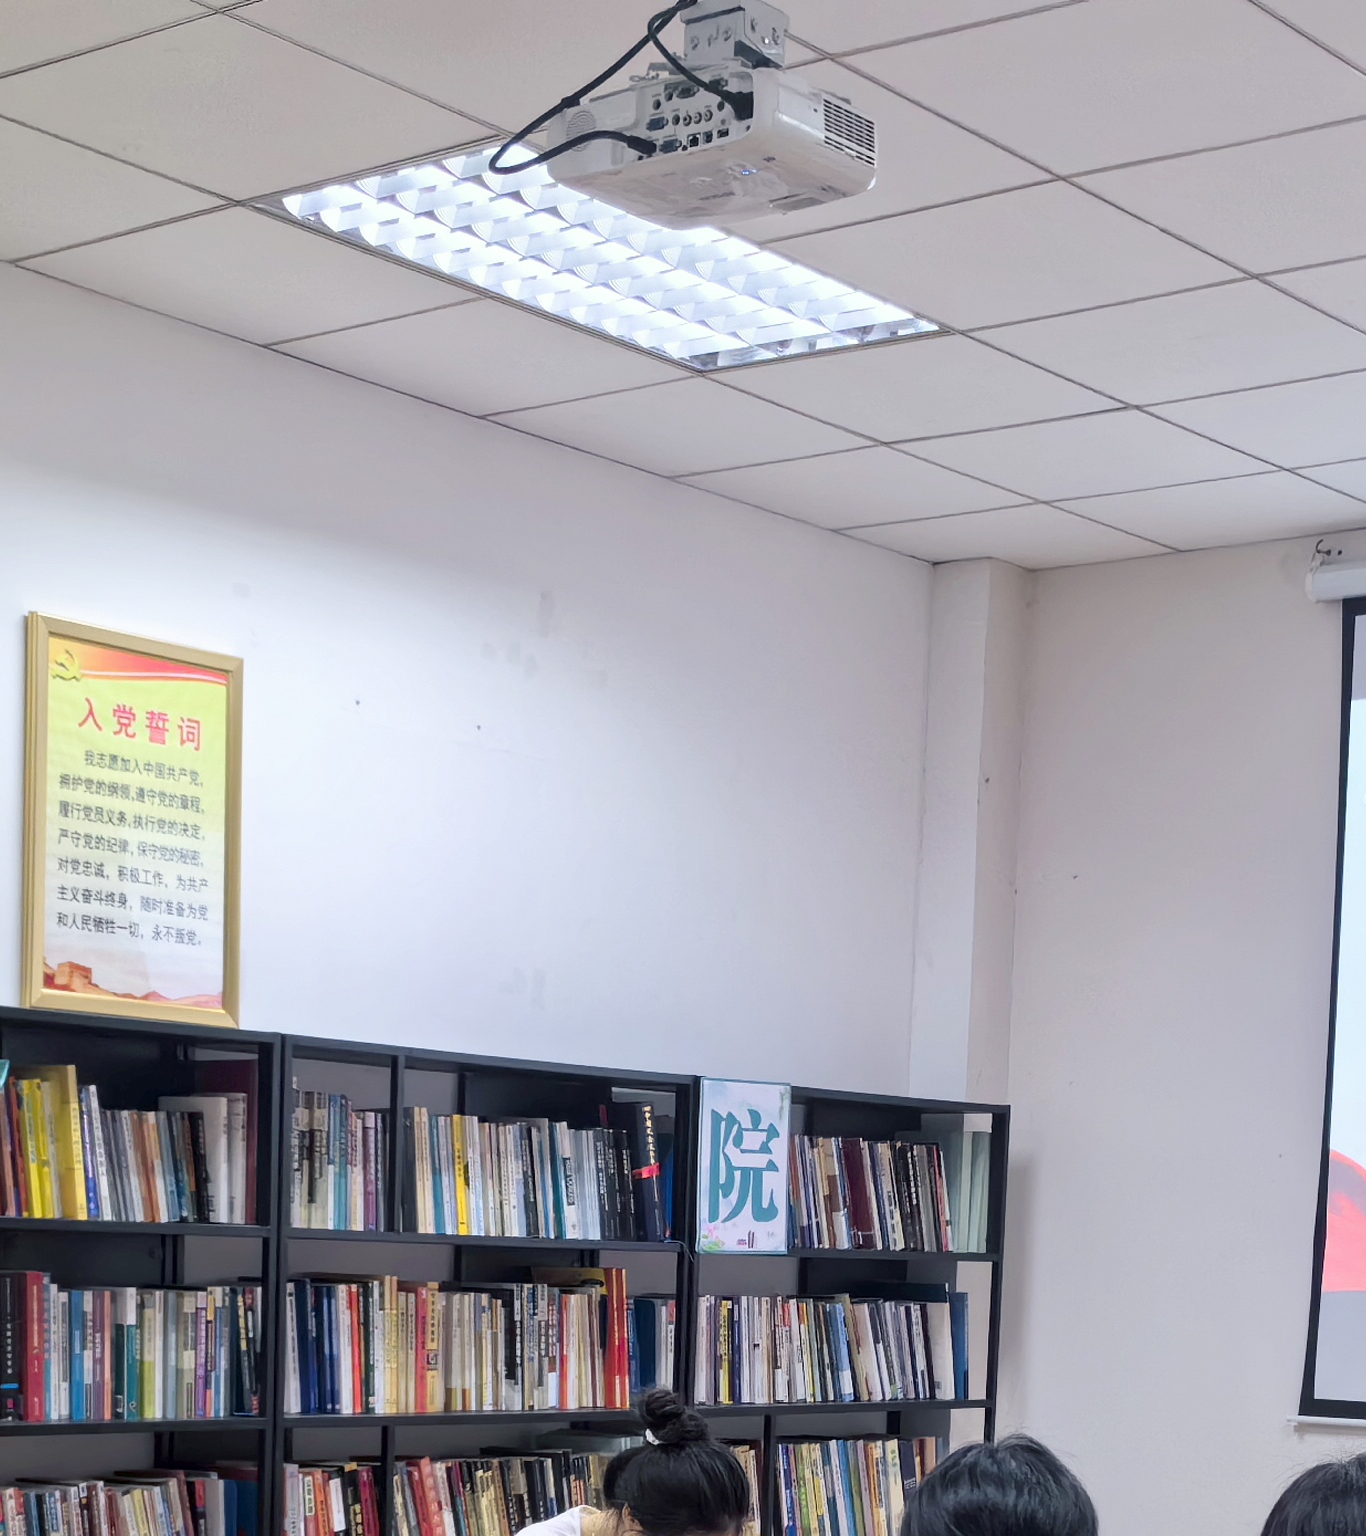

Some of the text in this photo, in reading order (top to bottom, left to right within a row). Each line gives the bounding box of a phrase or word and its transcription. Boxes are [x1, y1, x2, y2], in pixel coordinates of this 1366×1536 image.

[78, 695, 202, 753] 入党誓词
[84, 749, 203, 788] 我志愿加入中国共产党，
[57, 855, 208, 895] 对党忠诚，积极工作，为共产
[57, 883, 208, 921] 主义奋斗终身，随时准备为党
[708, 1108, 780, 1224] 院
